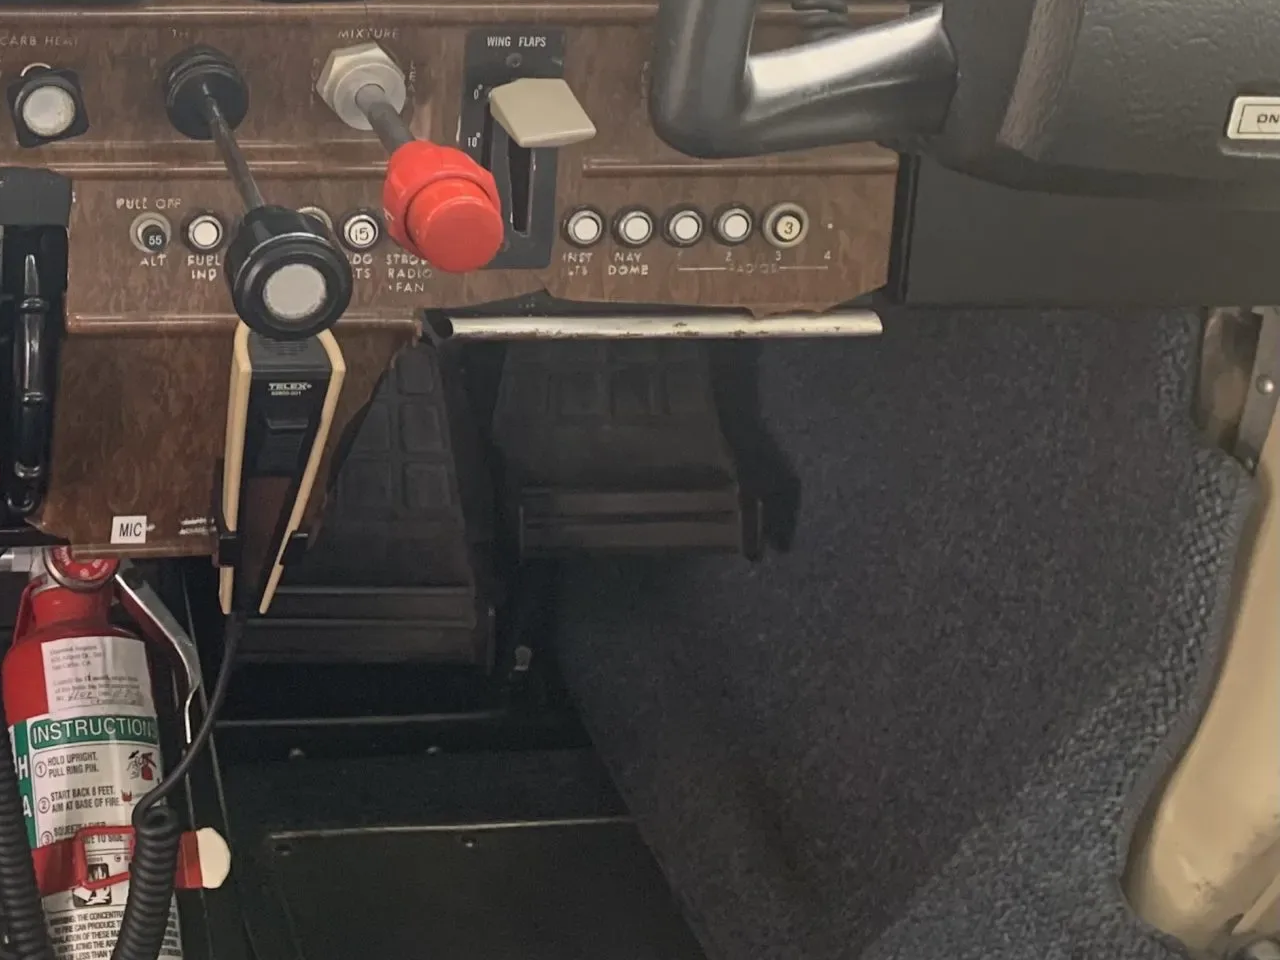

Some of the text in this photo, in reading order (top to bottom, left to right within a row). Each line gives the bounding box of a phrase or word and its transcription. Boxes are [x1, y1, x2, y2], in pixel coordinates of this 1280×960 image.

[486, 36, 547, 48] WING FLAPS
[115, 197, 181, 210] PULL OFF
[354, 227, 369, 241] 15
[783, 221, 793, 235] 3
[148, 234, 162, 246] 55
[139, 253, 221, 267] ALT FUEL
[191, 267, 433, 281] IND RADIO
[607, 263, 650, 276] DOME
[395, 282, 425, 293] FAN
[118, 522, 143, 537] MIC
[47, 755, 65, 766] HOLD
